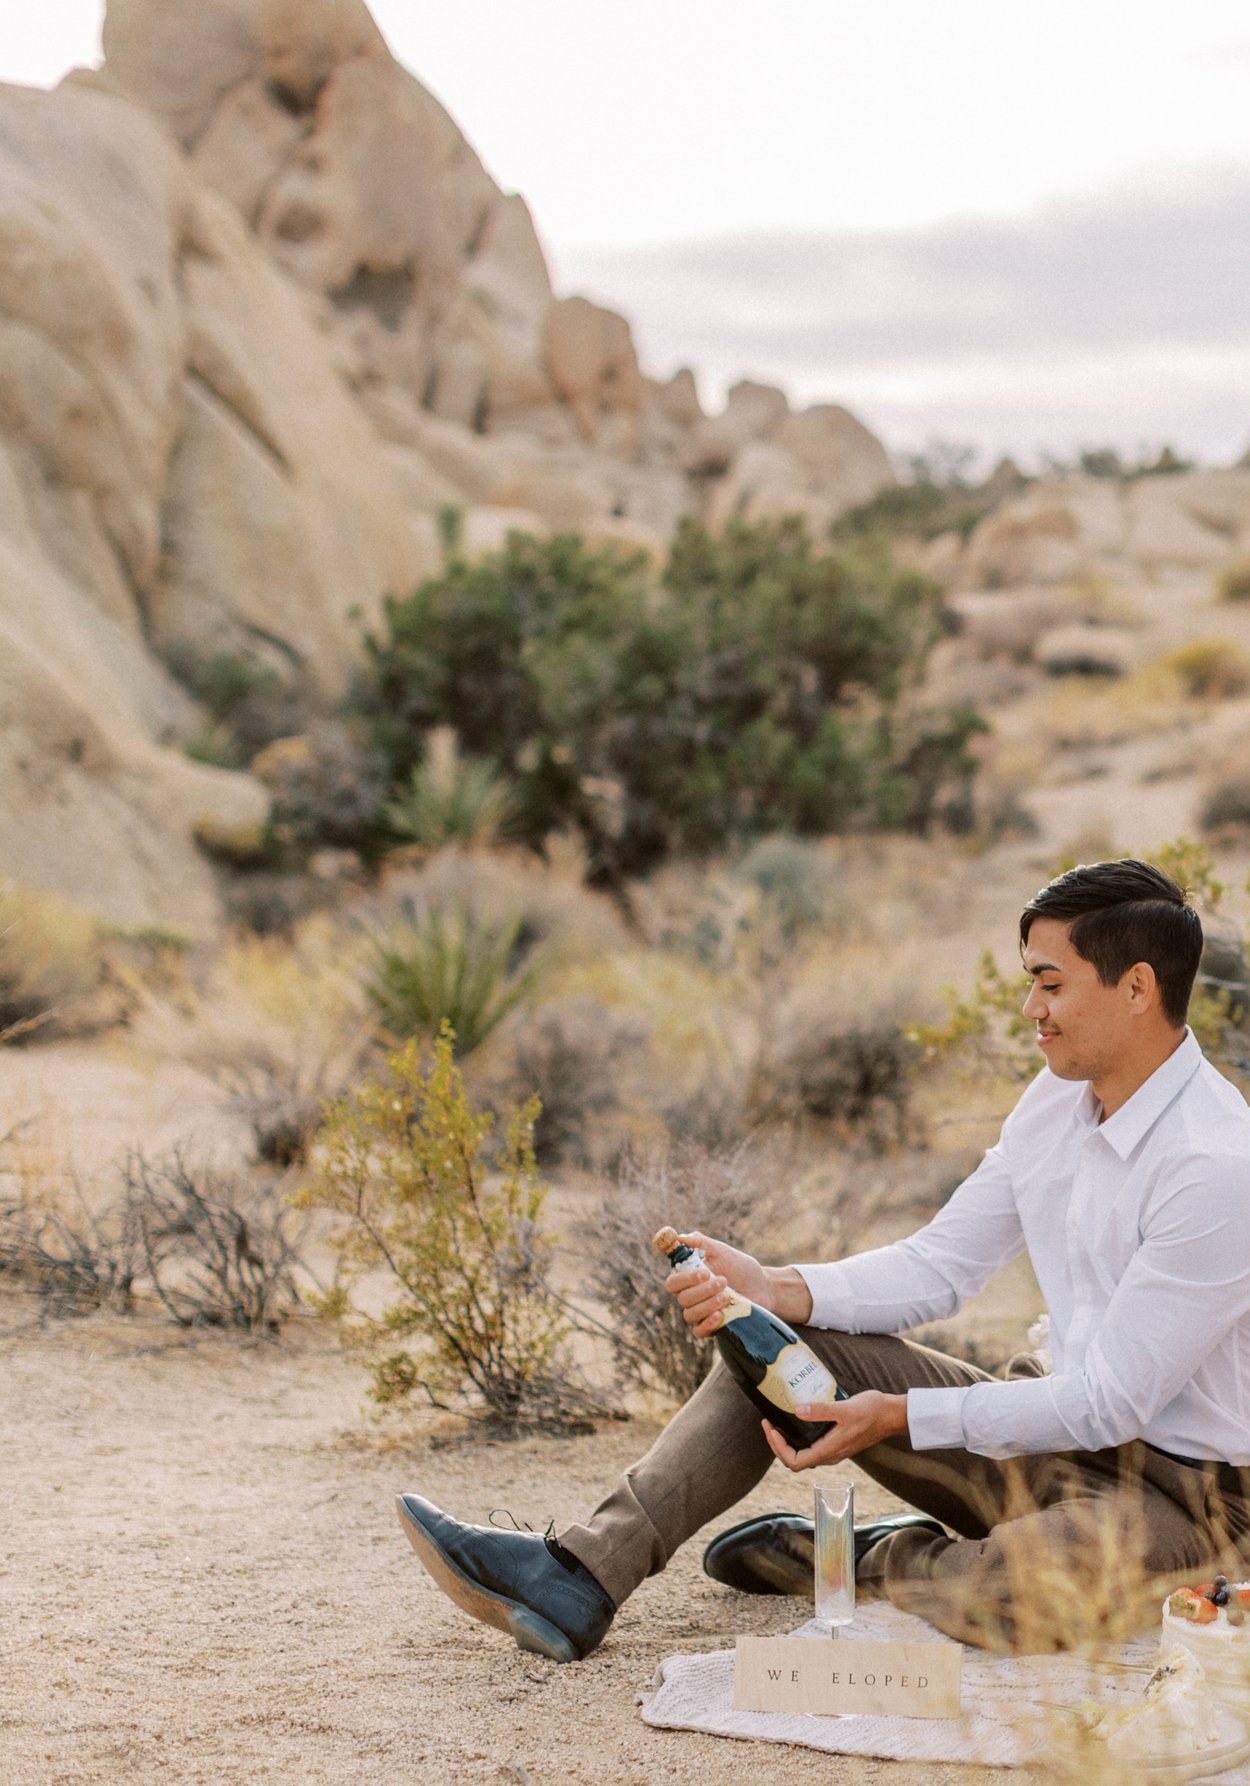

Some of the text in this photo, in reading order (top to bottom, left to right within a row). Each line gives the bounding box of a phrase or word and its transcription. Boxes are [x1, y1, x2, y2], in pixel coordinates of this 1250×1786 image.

[789, 1361, 817, 1388] KORBEL
[767, 1669, 928, 1688] WE ELOPED
